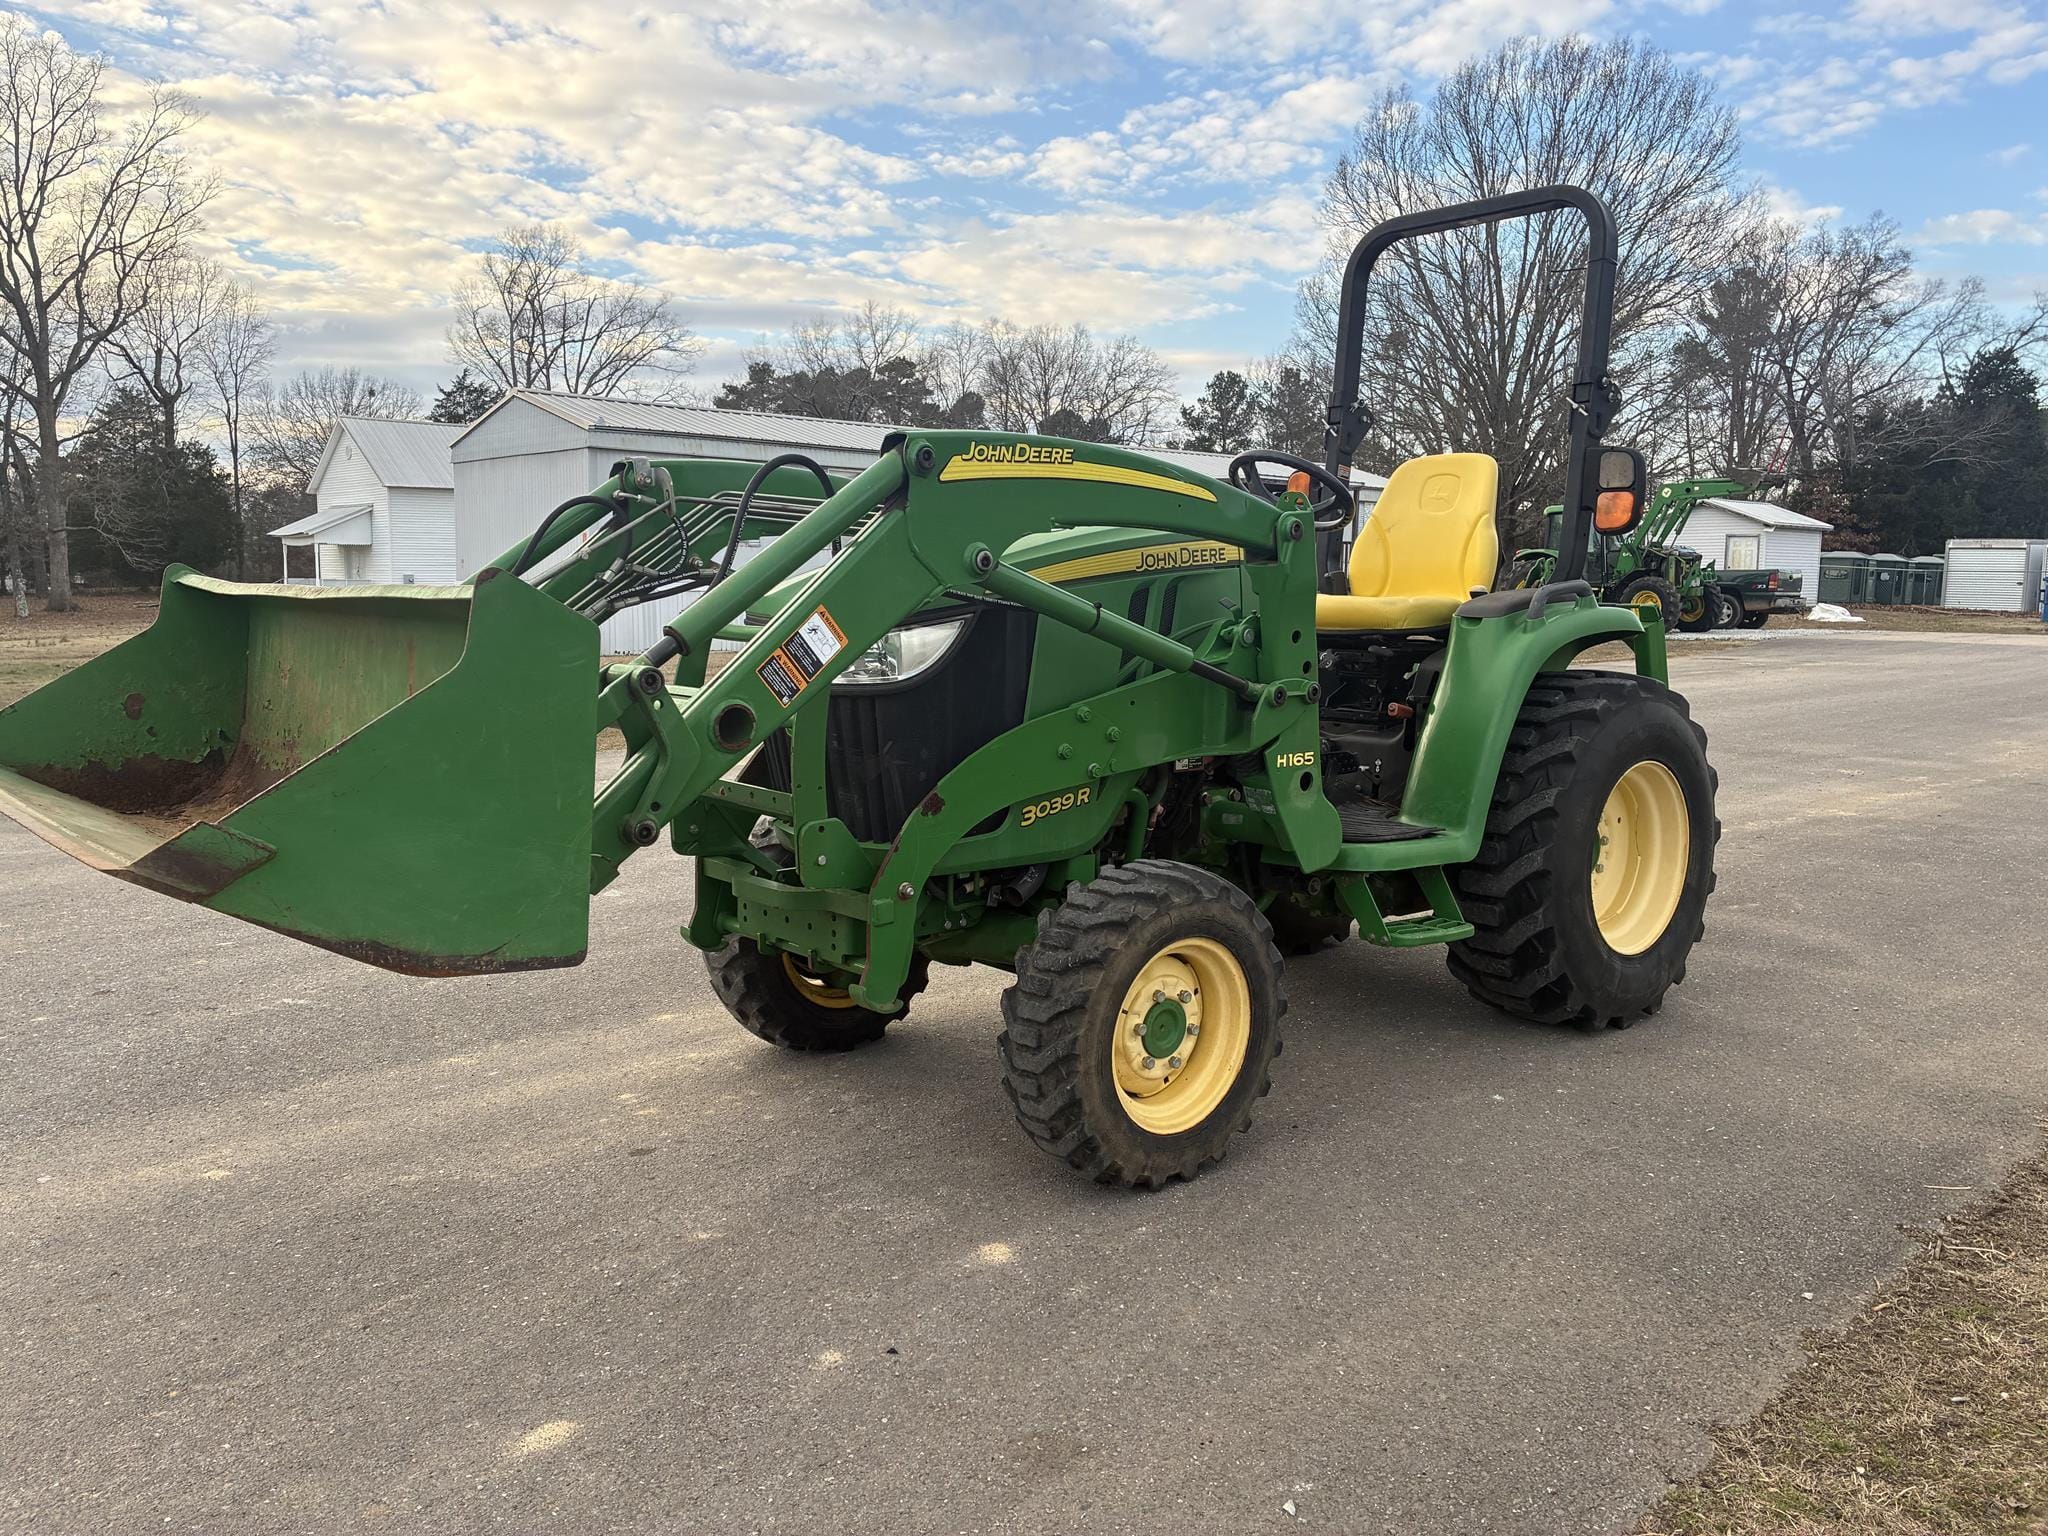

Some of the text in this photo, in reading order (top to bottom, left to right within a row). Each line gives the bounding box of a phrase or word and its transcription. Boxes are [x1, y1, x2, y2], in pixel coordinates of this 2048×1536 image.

[961, 441, 1074, 464] JOHN DEERE
[1135, 547, 1226, 571] JOHN DEERE
[824, 614, 844, 642] WARNING
[782, 660, 803, 686] WARNING
[1276, 751, 1315, 768] H165
